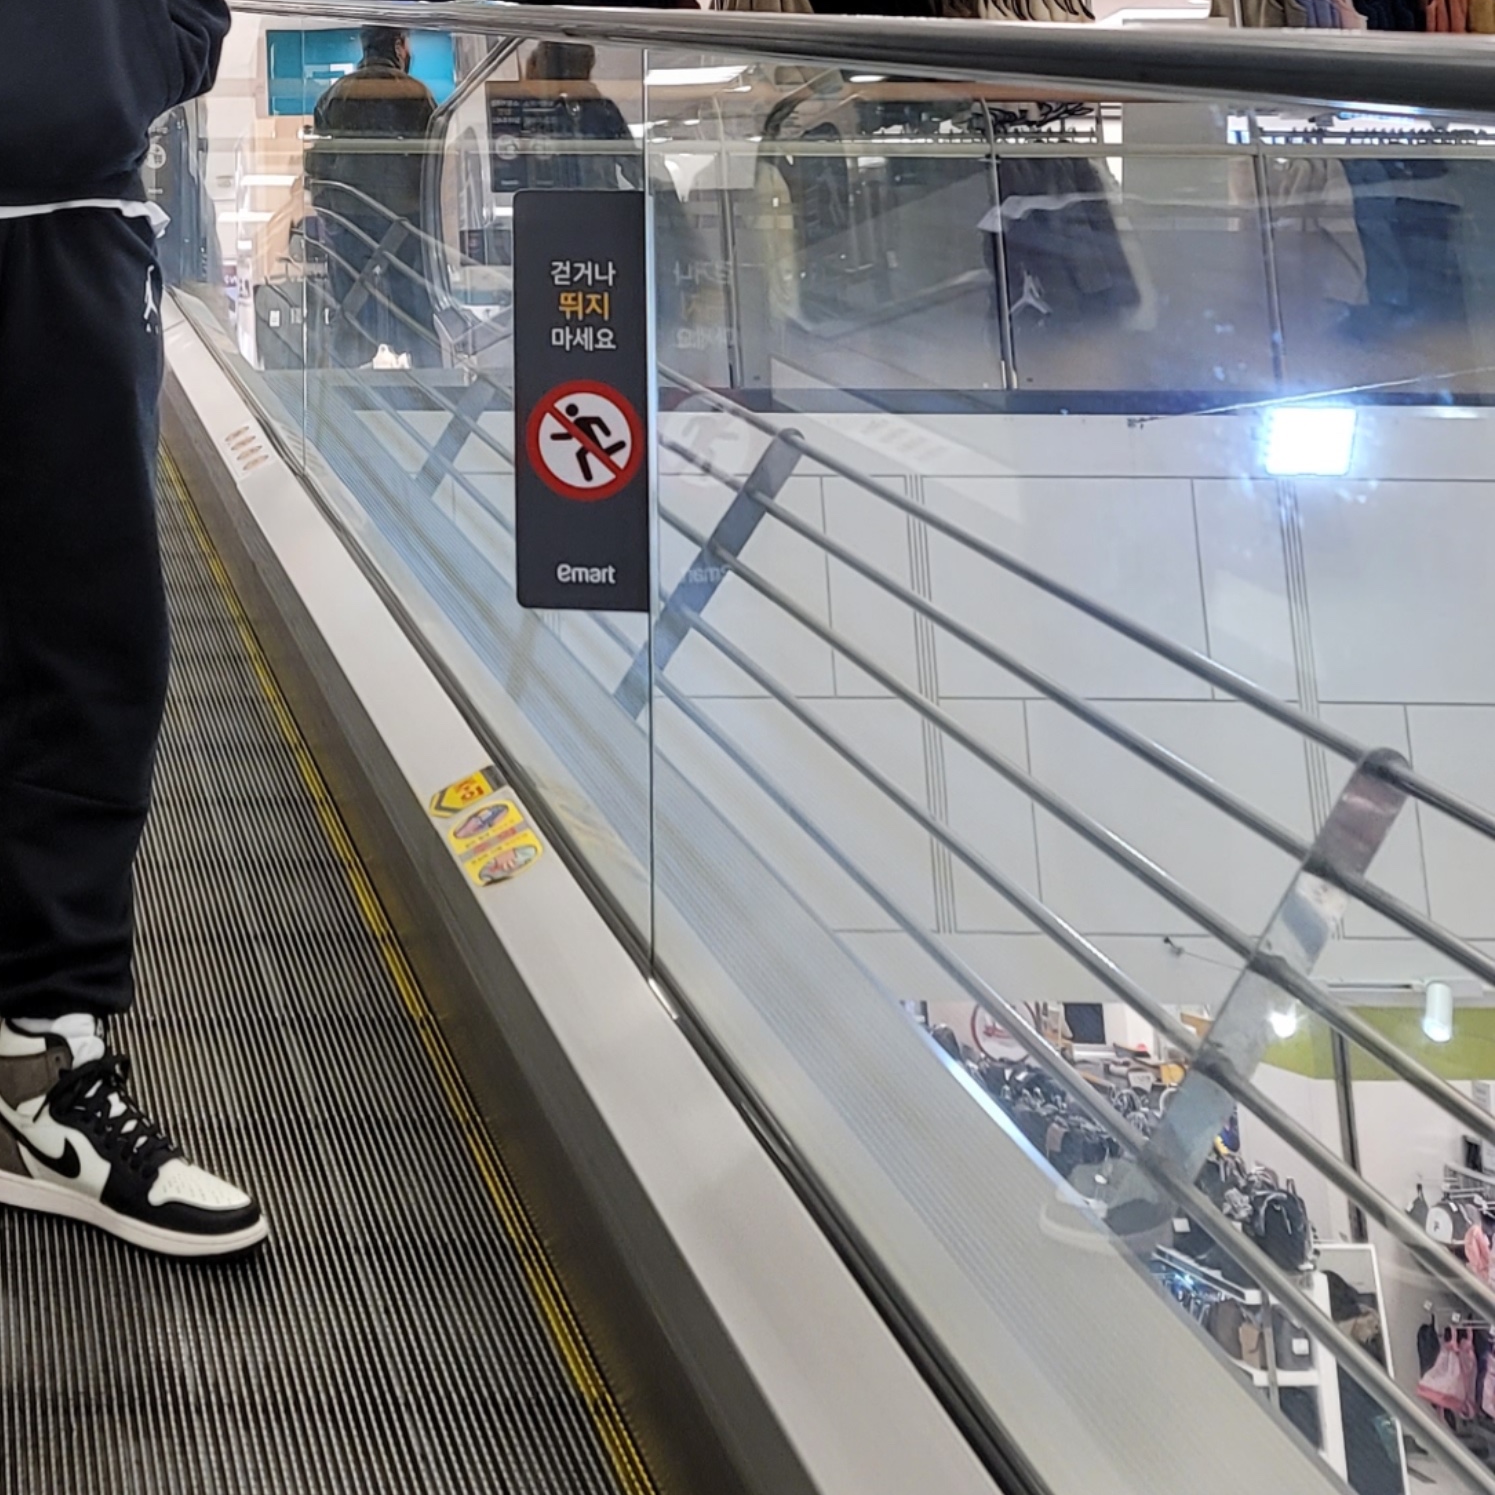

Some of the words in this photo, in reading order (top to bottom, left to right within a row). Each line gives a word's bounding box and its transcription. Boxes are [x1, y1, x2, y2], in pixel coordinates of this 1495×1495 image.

[550, 260, 617, 287] 걷거나
[558, 291, 610, 321] 뛰지
[550, 326, 617, 352] 마세요
[556, 563, 617, 585] emart
